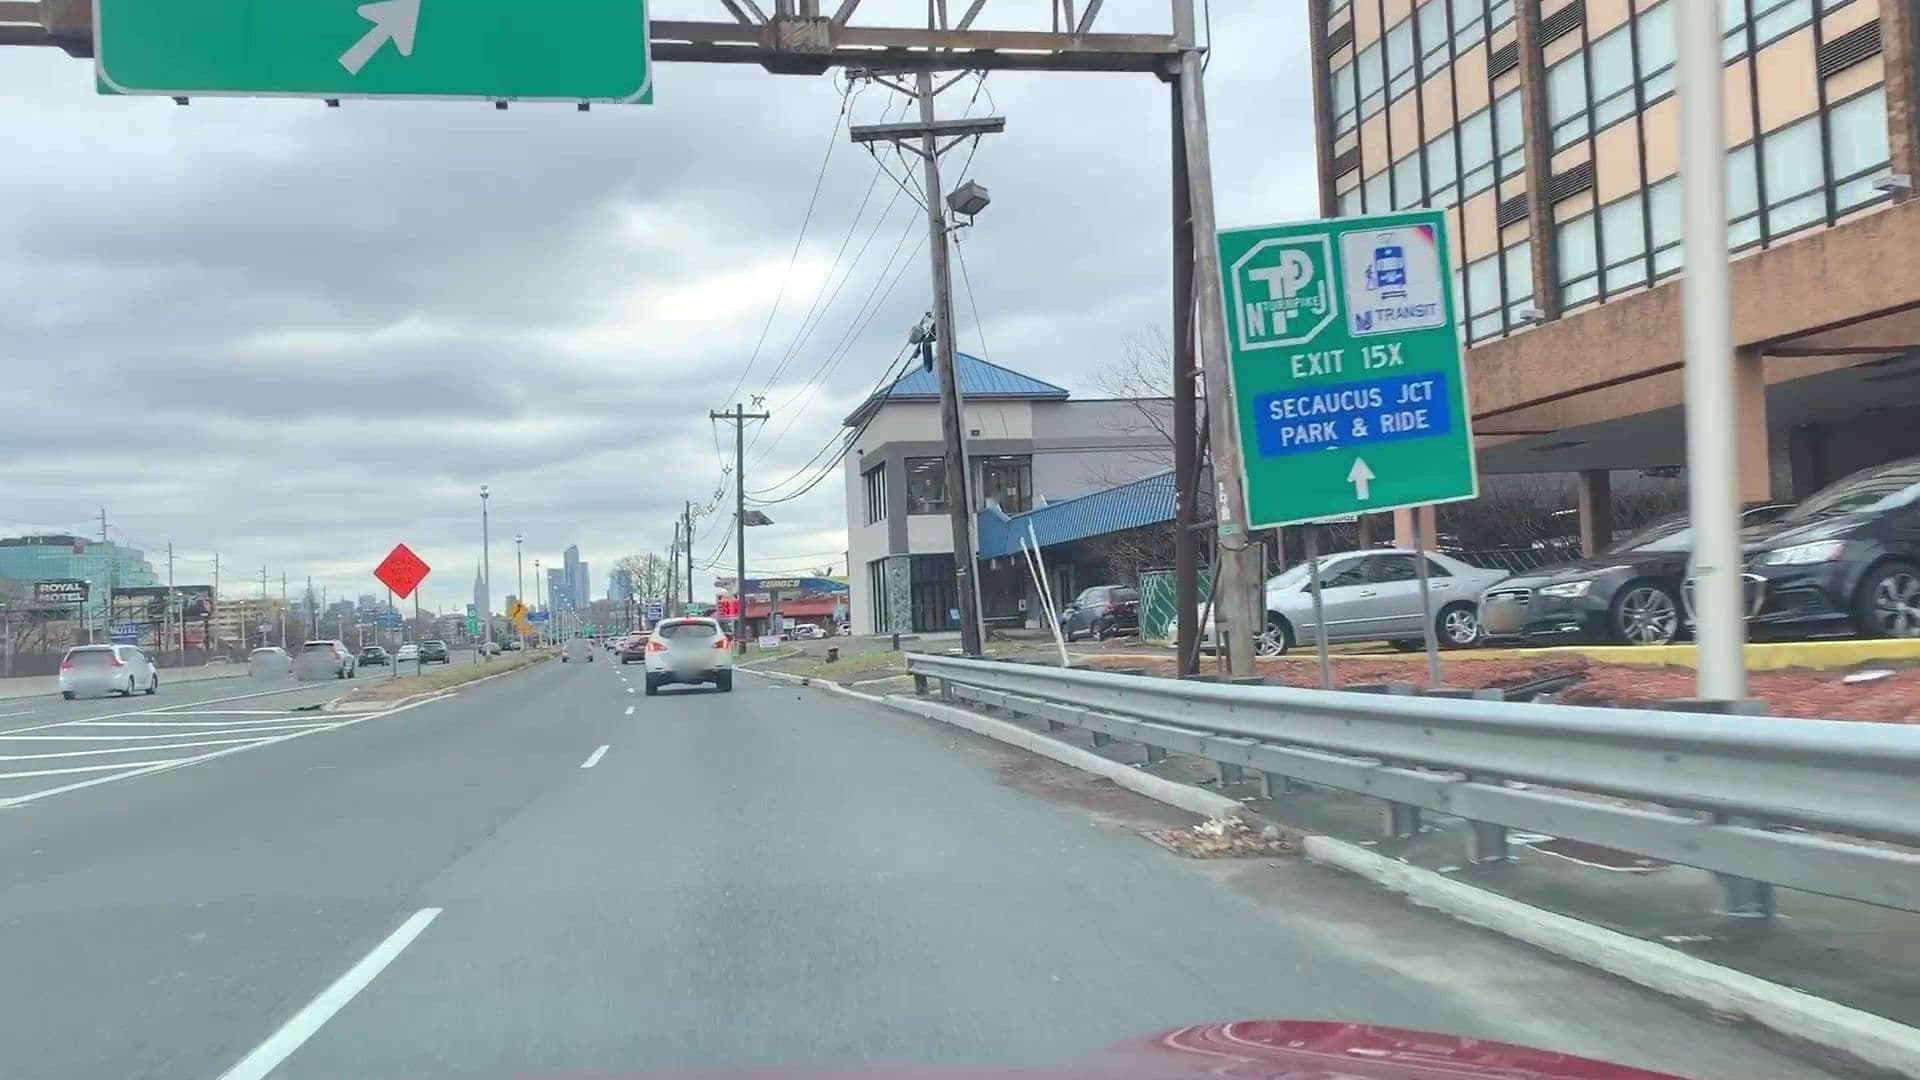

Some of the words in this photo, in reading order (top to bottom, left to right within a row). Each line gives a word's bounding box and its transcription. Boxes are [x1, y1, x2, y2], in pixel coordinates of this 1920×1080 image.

[1377, 303, 1438, 322] TRANSIT
[1291, 349, 1345, 378] EXIT
[1361, 342, 1404, 369] 15X
[1270, 387, 1383, 420] SECAUCUS
[1396, 381, 1434, 404] JCT
[1281, 421, 1339, 446] PARK
[1352, 417, 1368, 437] &
[1380, 409, 1430, 433] RIDE
[40, 583, 82, 592] ROYAL
[759, 579, 801, 589] SUNOCO
[39, 593, 84, 602] MOTEL
